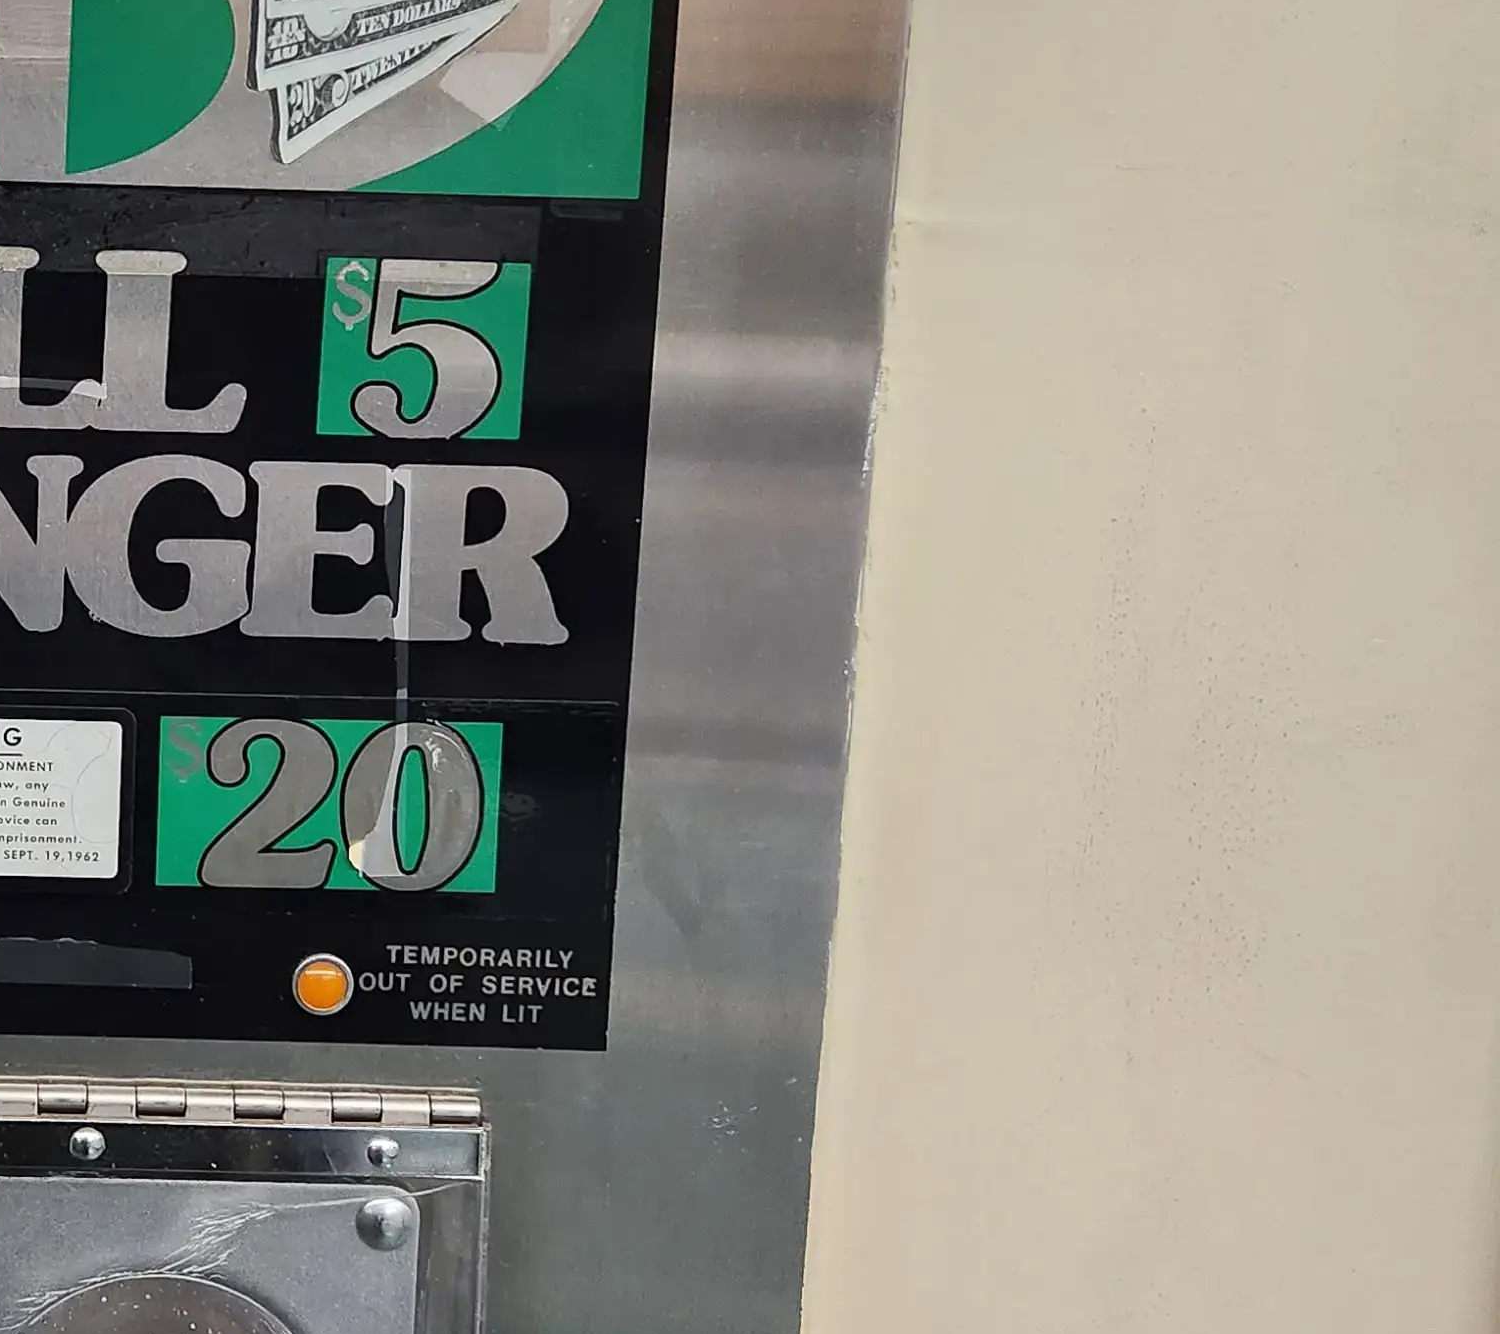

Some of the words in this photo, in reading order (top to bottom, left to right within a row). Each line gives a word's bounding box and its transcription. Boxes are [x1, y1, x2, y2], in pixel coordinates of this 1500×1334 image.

[356, 12, 392, 38] TEN
[331, 257, 502, 440] $5
[25, 782, 49, 793] any
[12, 796, 66, 808] Genuine
[165, 717, 485, 891] $20
[35, 818, 58, 826] can
[3, 849, 38, 861] SEPT.
[386, 943, 574, 970] TEMPORARILY
[358, 971, 411, 993] OUT
[428, 973, 464, 995] OF
[481, 975, 598, 997] SERVICE
[410, 1001, 486, 1023] WHEN
[501, 1003, 543, 1025] LIT
